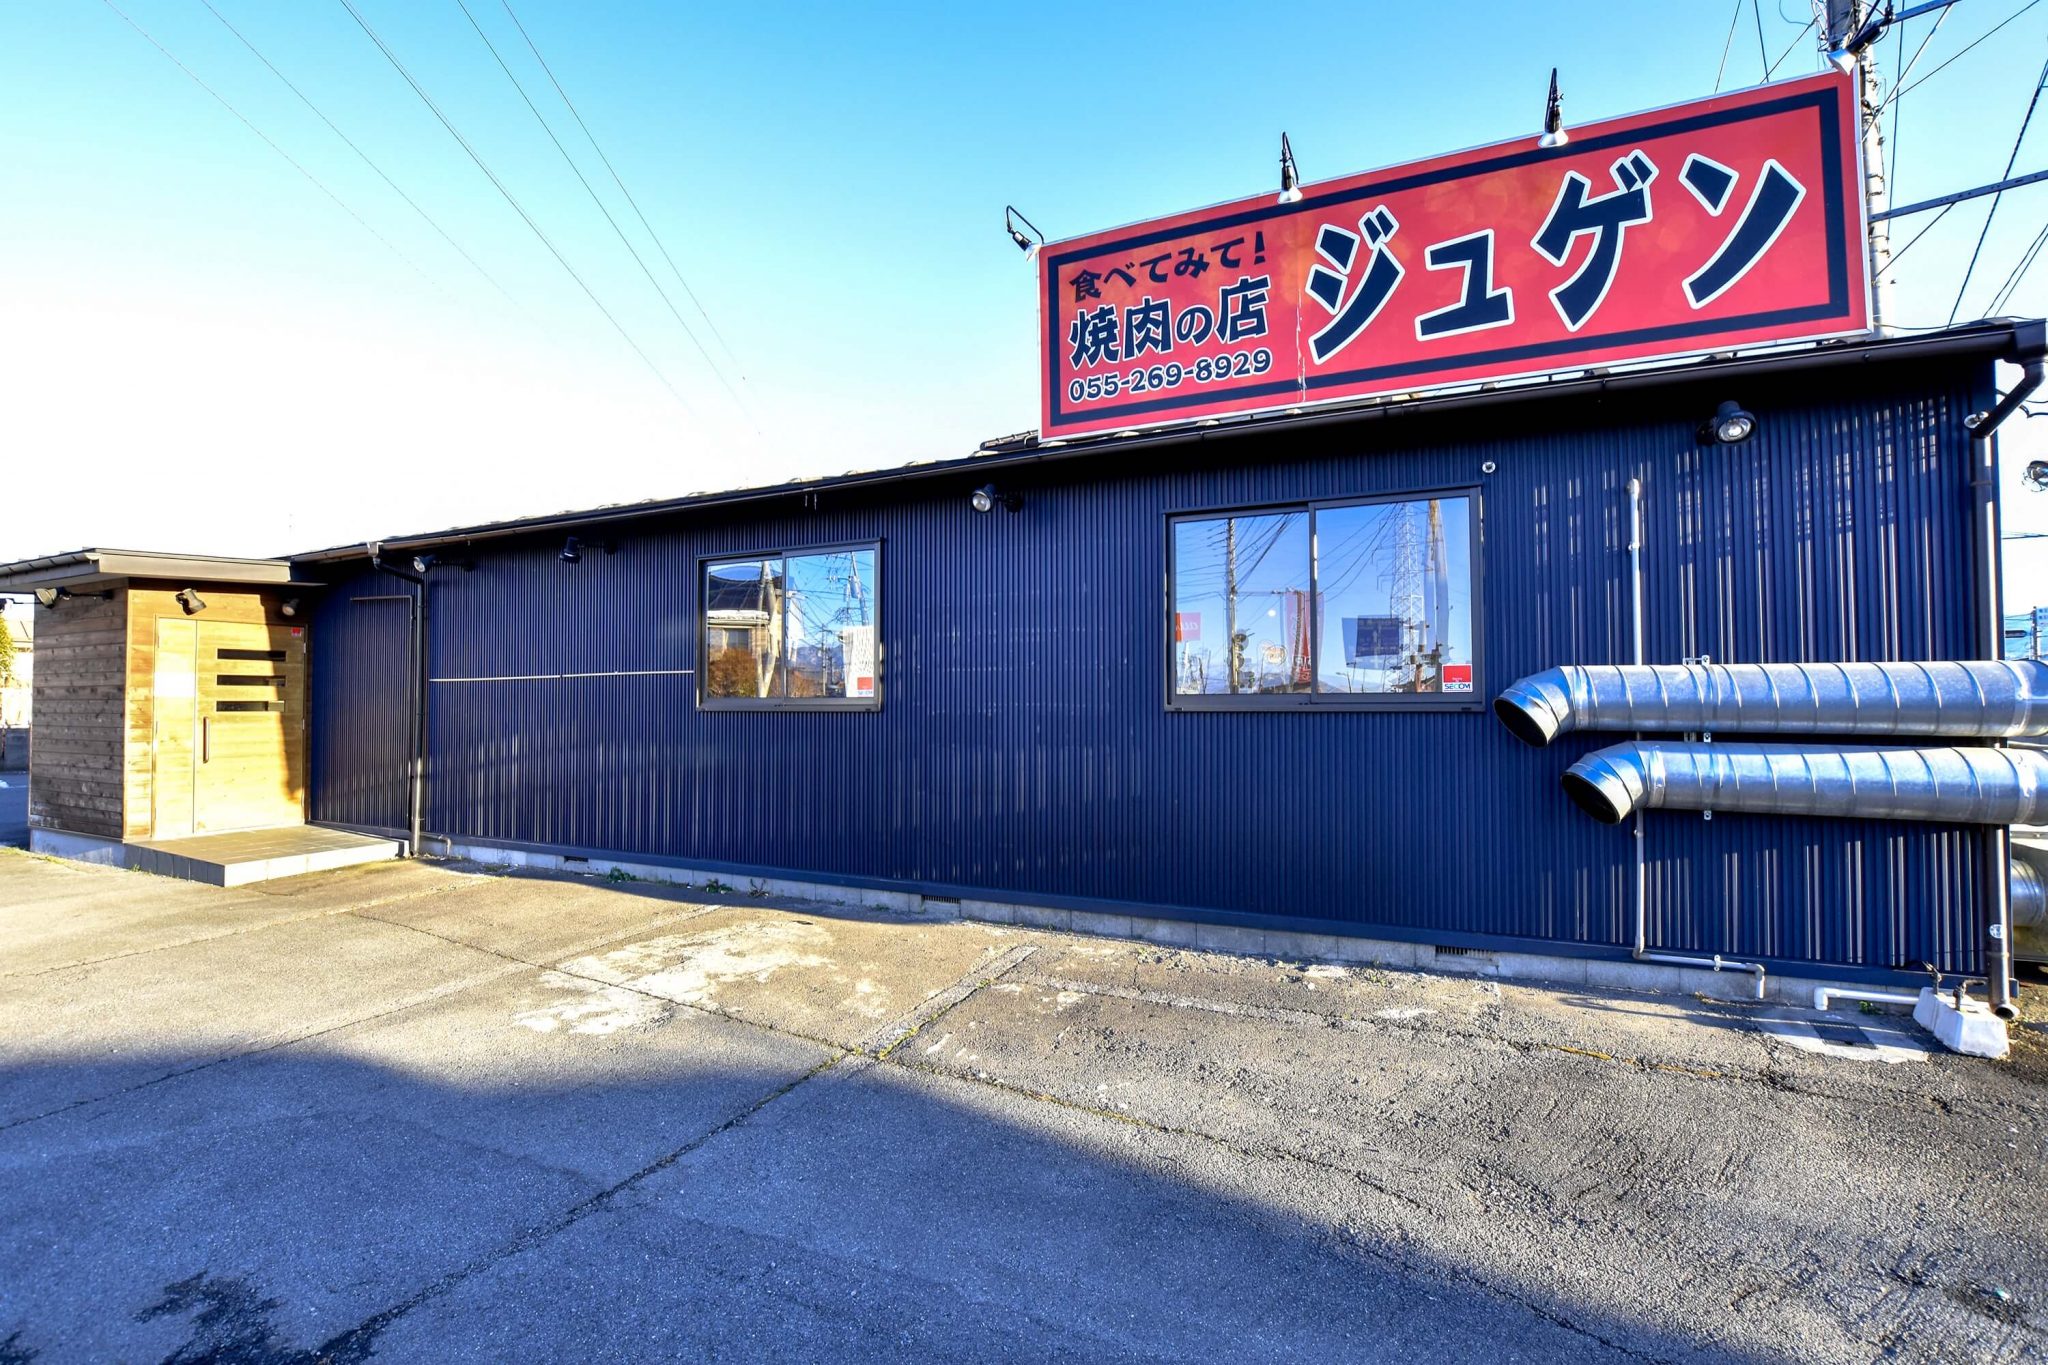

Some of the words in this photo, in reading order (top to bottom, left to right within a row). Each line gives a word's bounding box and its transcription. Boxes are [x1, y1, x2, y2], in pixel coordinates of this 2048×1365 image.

[1069, 231, 1266, 302] 食べてみて！
[1305, 149, 1807, 365] ジュゲン
[1068, 275, 1271, 370] 焼肉の店
[1069, 347, 1272, 402] 055-269-8929
